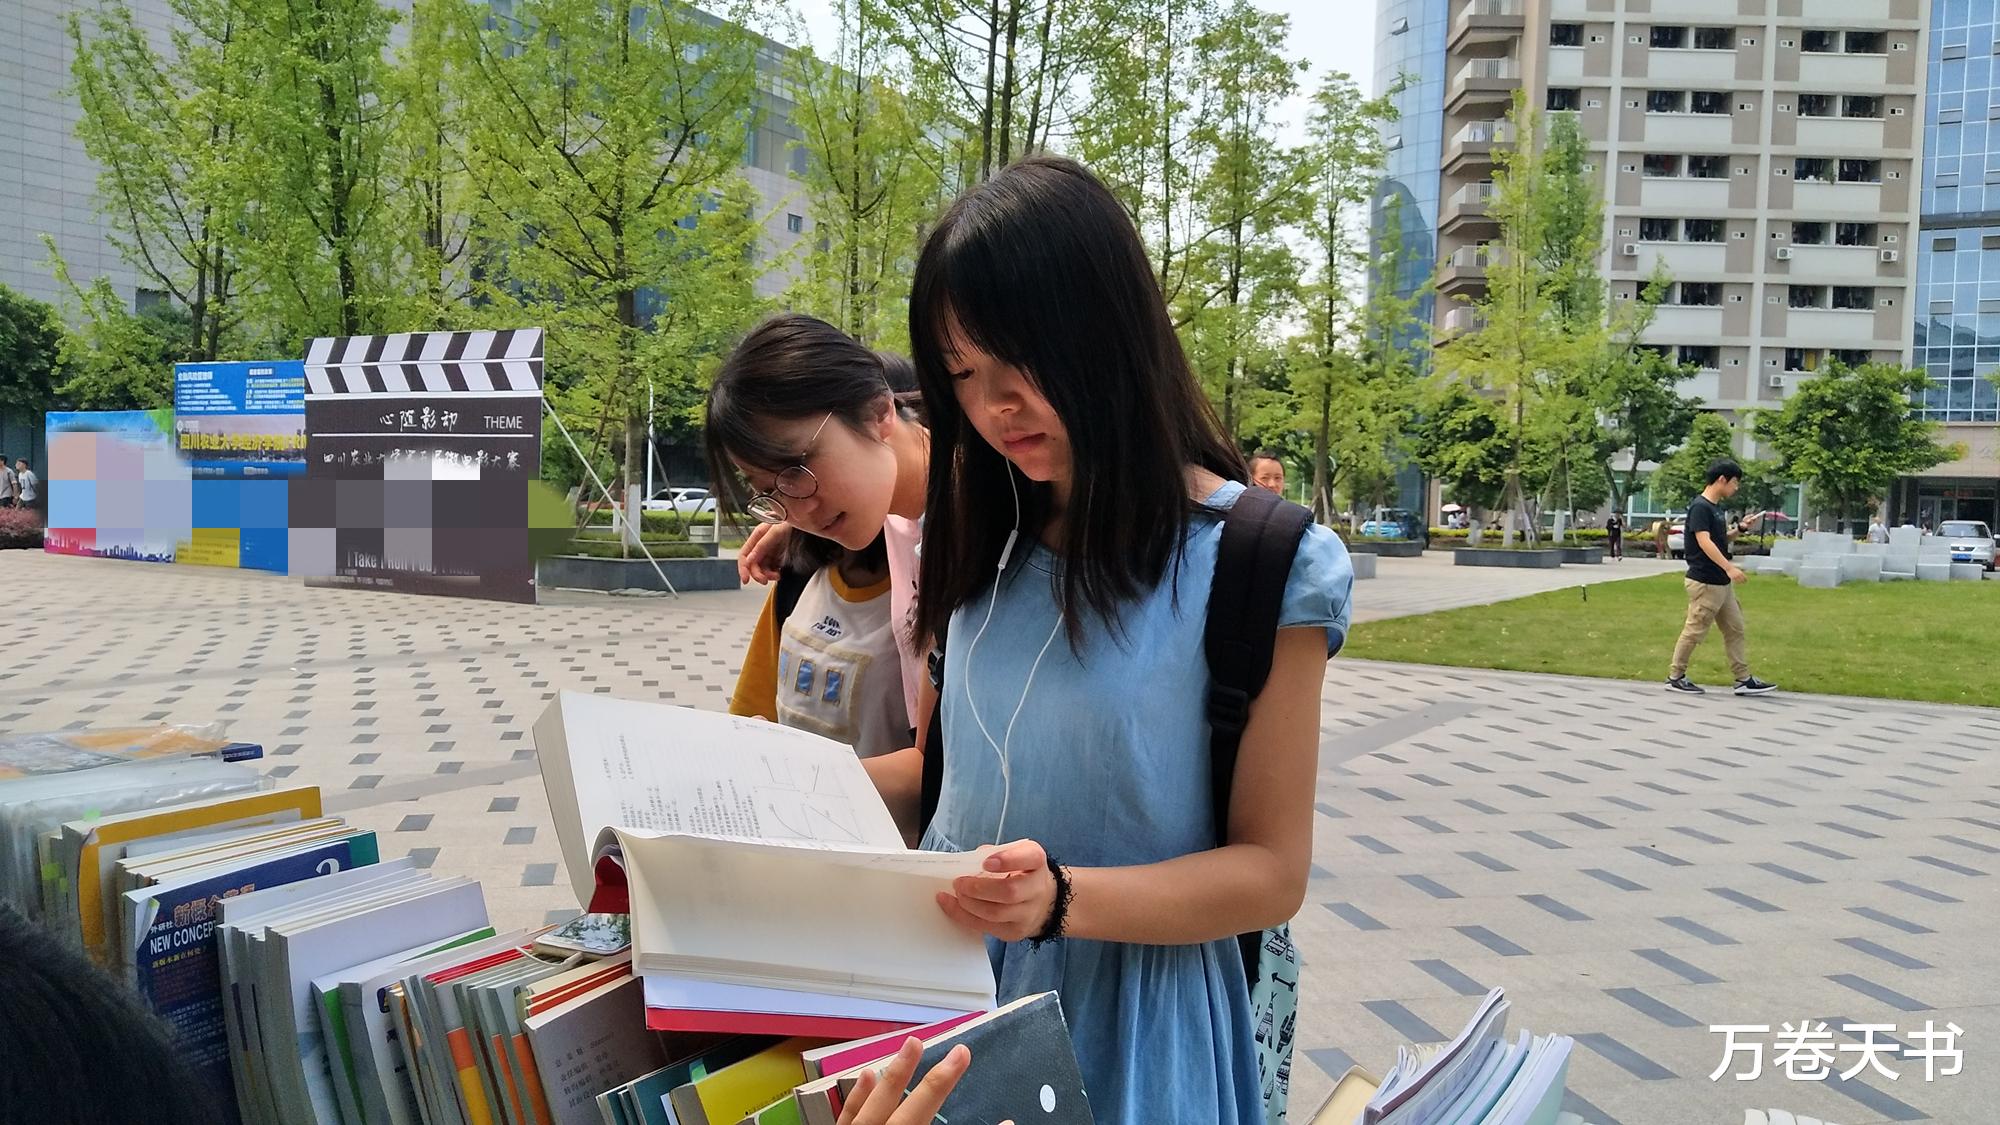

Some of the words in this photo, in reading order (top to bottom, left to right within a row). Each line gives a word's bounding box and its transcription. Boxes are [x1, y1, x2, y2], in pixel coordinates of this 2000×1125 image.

[484, 416, 523, 429] THEME
[354, 551, 377, 568] Take
[150, 921, 173, 935] 外研社
[150, 933, 171, 955] NEW
